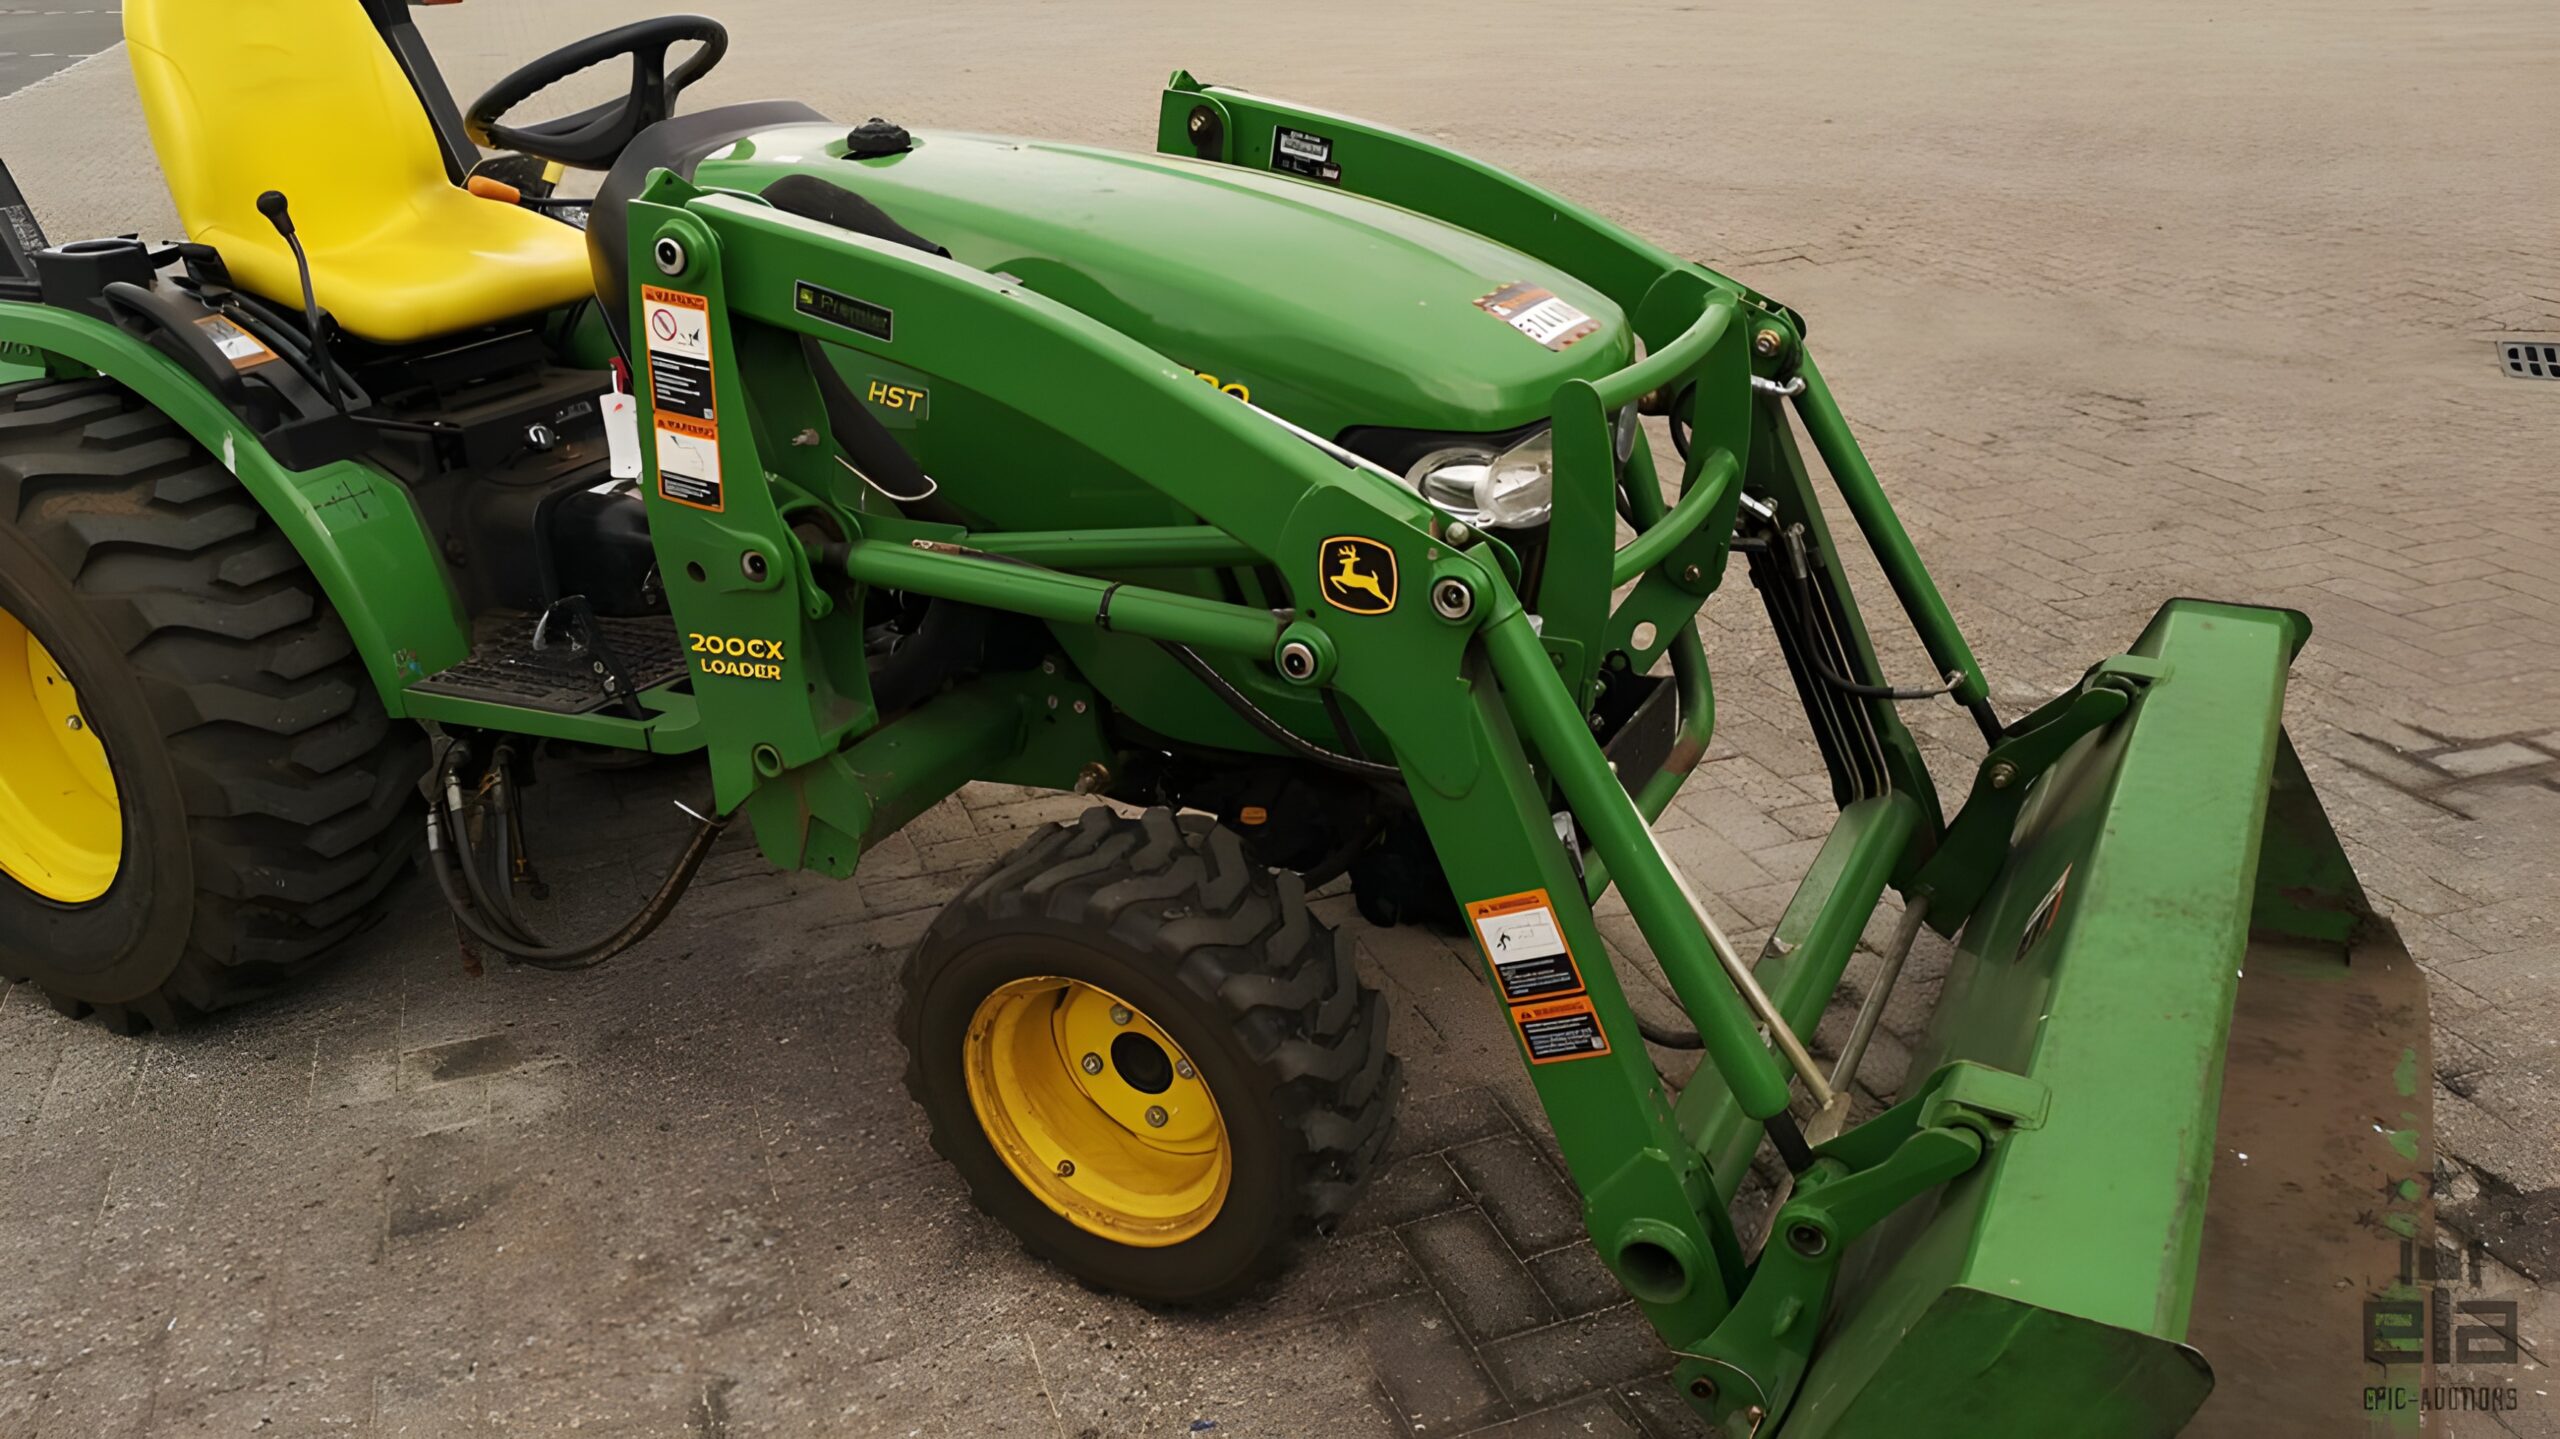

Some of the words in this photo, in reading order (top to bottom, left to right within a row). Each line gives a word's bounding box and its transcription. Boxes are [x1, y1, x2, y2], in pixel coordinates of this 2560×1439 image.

[868, 381, 924, 412] HST
[689, 633, 785, 660] 200CX
[701, 658, 781, 680] LOADER
